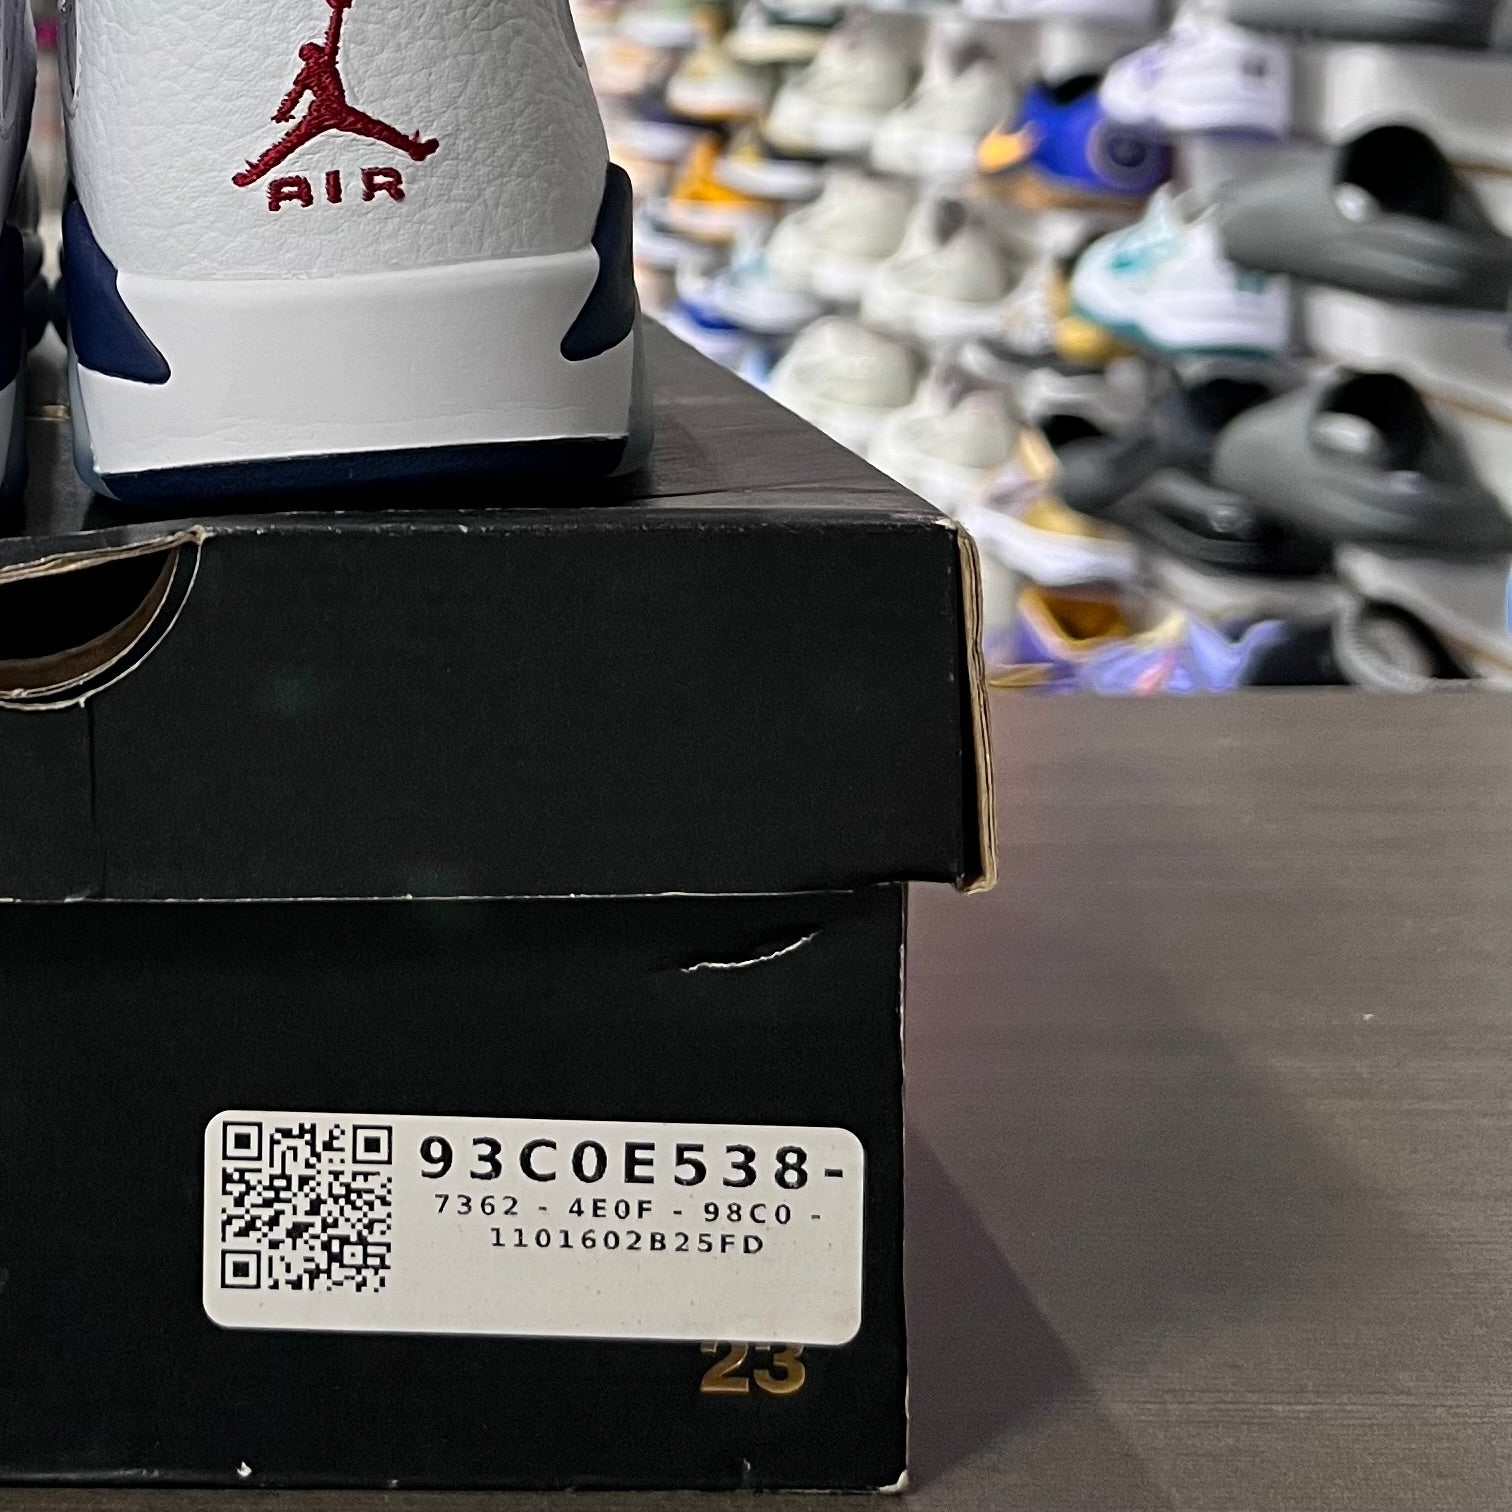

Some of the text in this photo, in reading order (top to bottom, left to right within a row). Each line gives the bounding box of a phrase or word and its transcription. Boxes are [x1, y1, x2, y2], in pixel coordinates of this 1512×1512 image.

[266, 165, 407, 213] AIR
[419, 1134, 844, 1191] 93C0E538-
[435, 1195, 519, 1217] 7362
[492, 1228, 764, 1255] 1101602B25FD
[699, 1341, 807, 1394] 23
